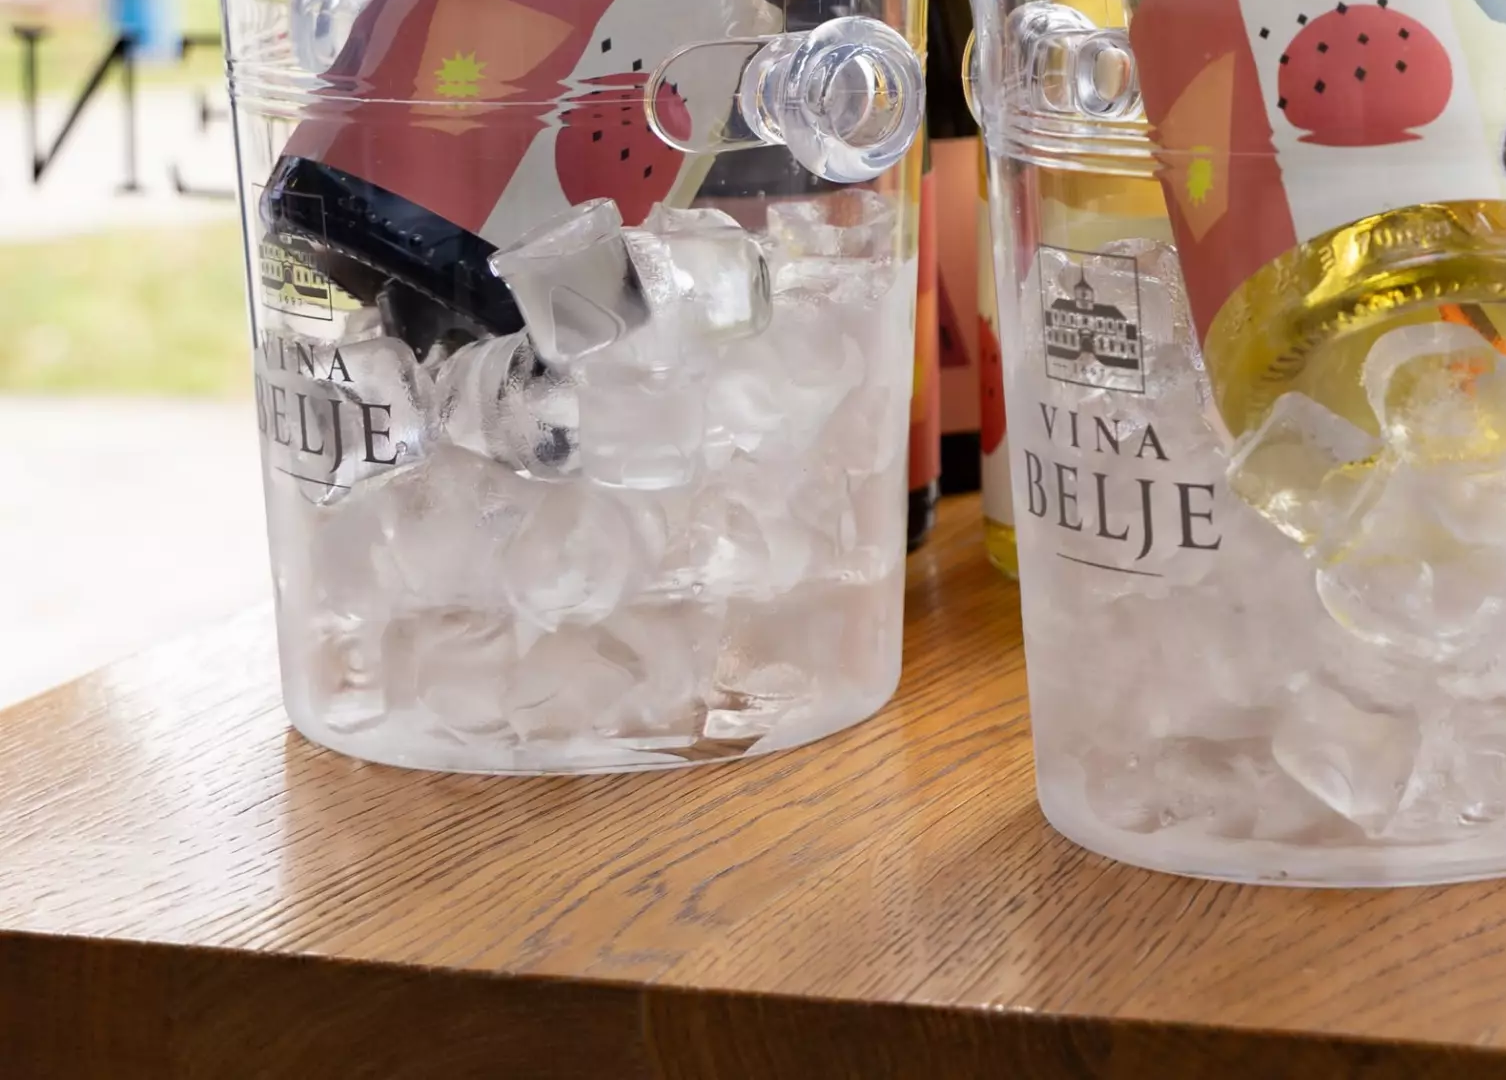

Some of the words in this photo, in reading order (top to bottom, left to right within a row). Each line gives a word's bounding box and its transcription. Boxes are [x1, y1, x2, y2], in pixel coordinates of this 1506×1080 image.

[261, 330, 354, 383] VINA
[256, 373, 400, 474] BELJE
[1039, 402, 1170, 461] VINA
[1024, 449, 1223, 560] BELJE
